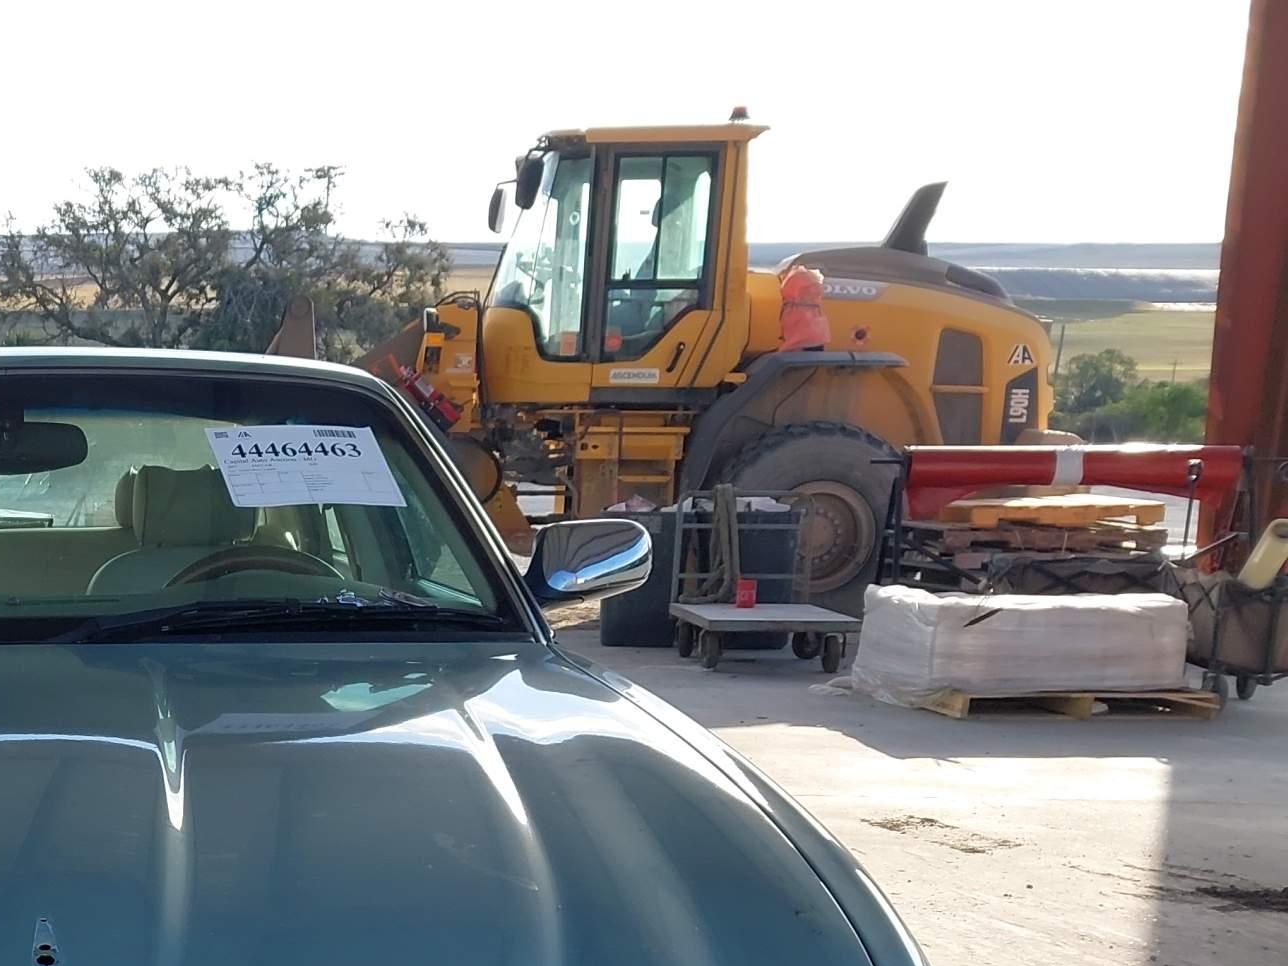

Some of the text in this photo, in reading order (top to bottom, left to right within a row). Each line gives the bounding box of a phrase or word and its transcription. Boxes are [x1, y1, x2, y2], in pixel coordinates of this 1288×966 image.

[824, 283, 877, 296] OLVO
[1008, 388, 1030, 423] L90H
[231, 441, 362, 458] 44464463
